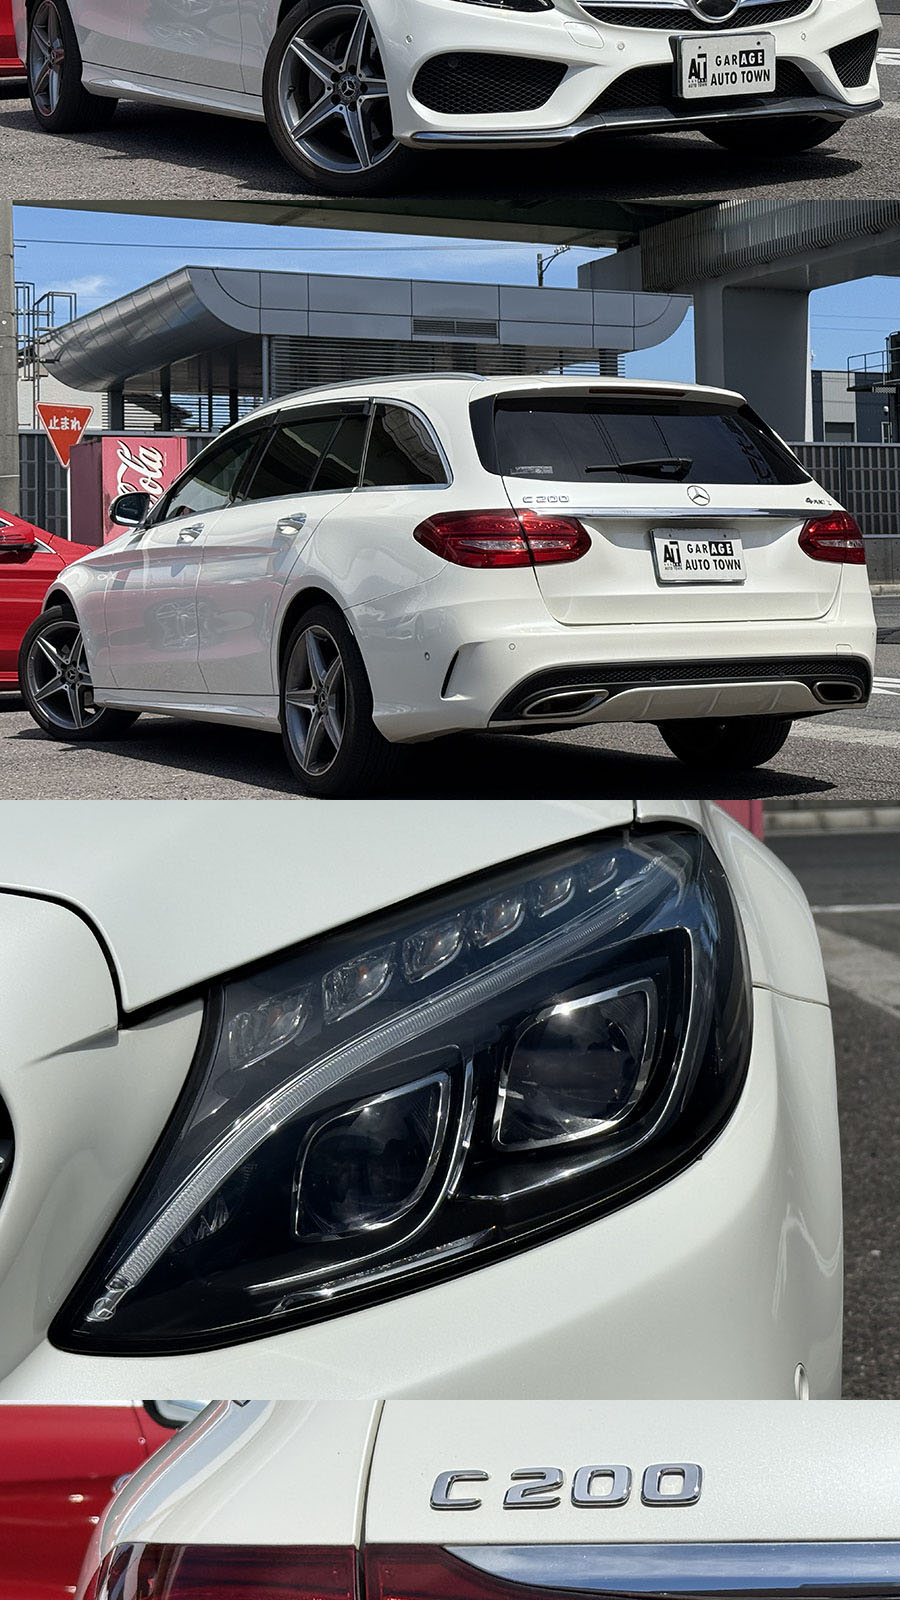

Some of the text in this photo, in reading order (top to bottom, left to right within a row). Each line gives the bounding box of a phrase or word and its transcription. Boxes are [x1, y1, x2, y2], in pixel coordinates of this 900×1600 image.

[715, 52, 764, 67] GARAGE
[710, 69, 770, 86] AUTO TOWN
[48, 415, 82, 431] 止まれ
[687, 543, 732, 555] GARAGE
[685, 559, 710, 570] AUTO
[713, 559, 741, 570] TOWN
